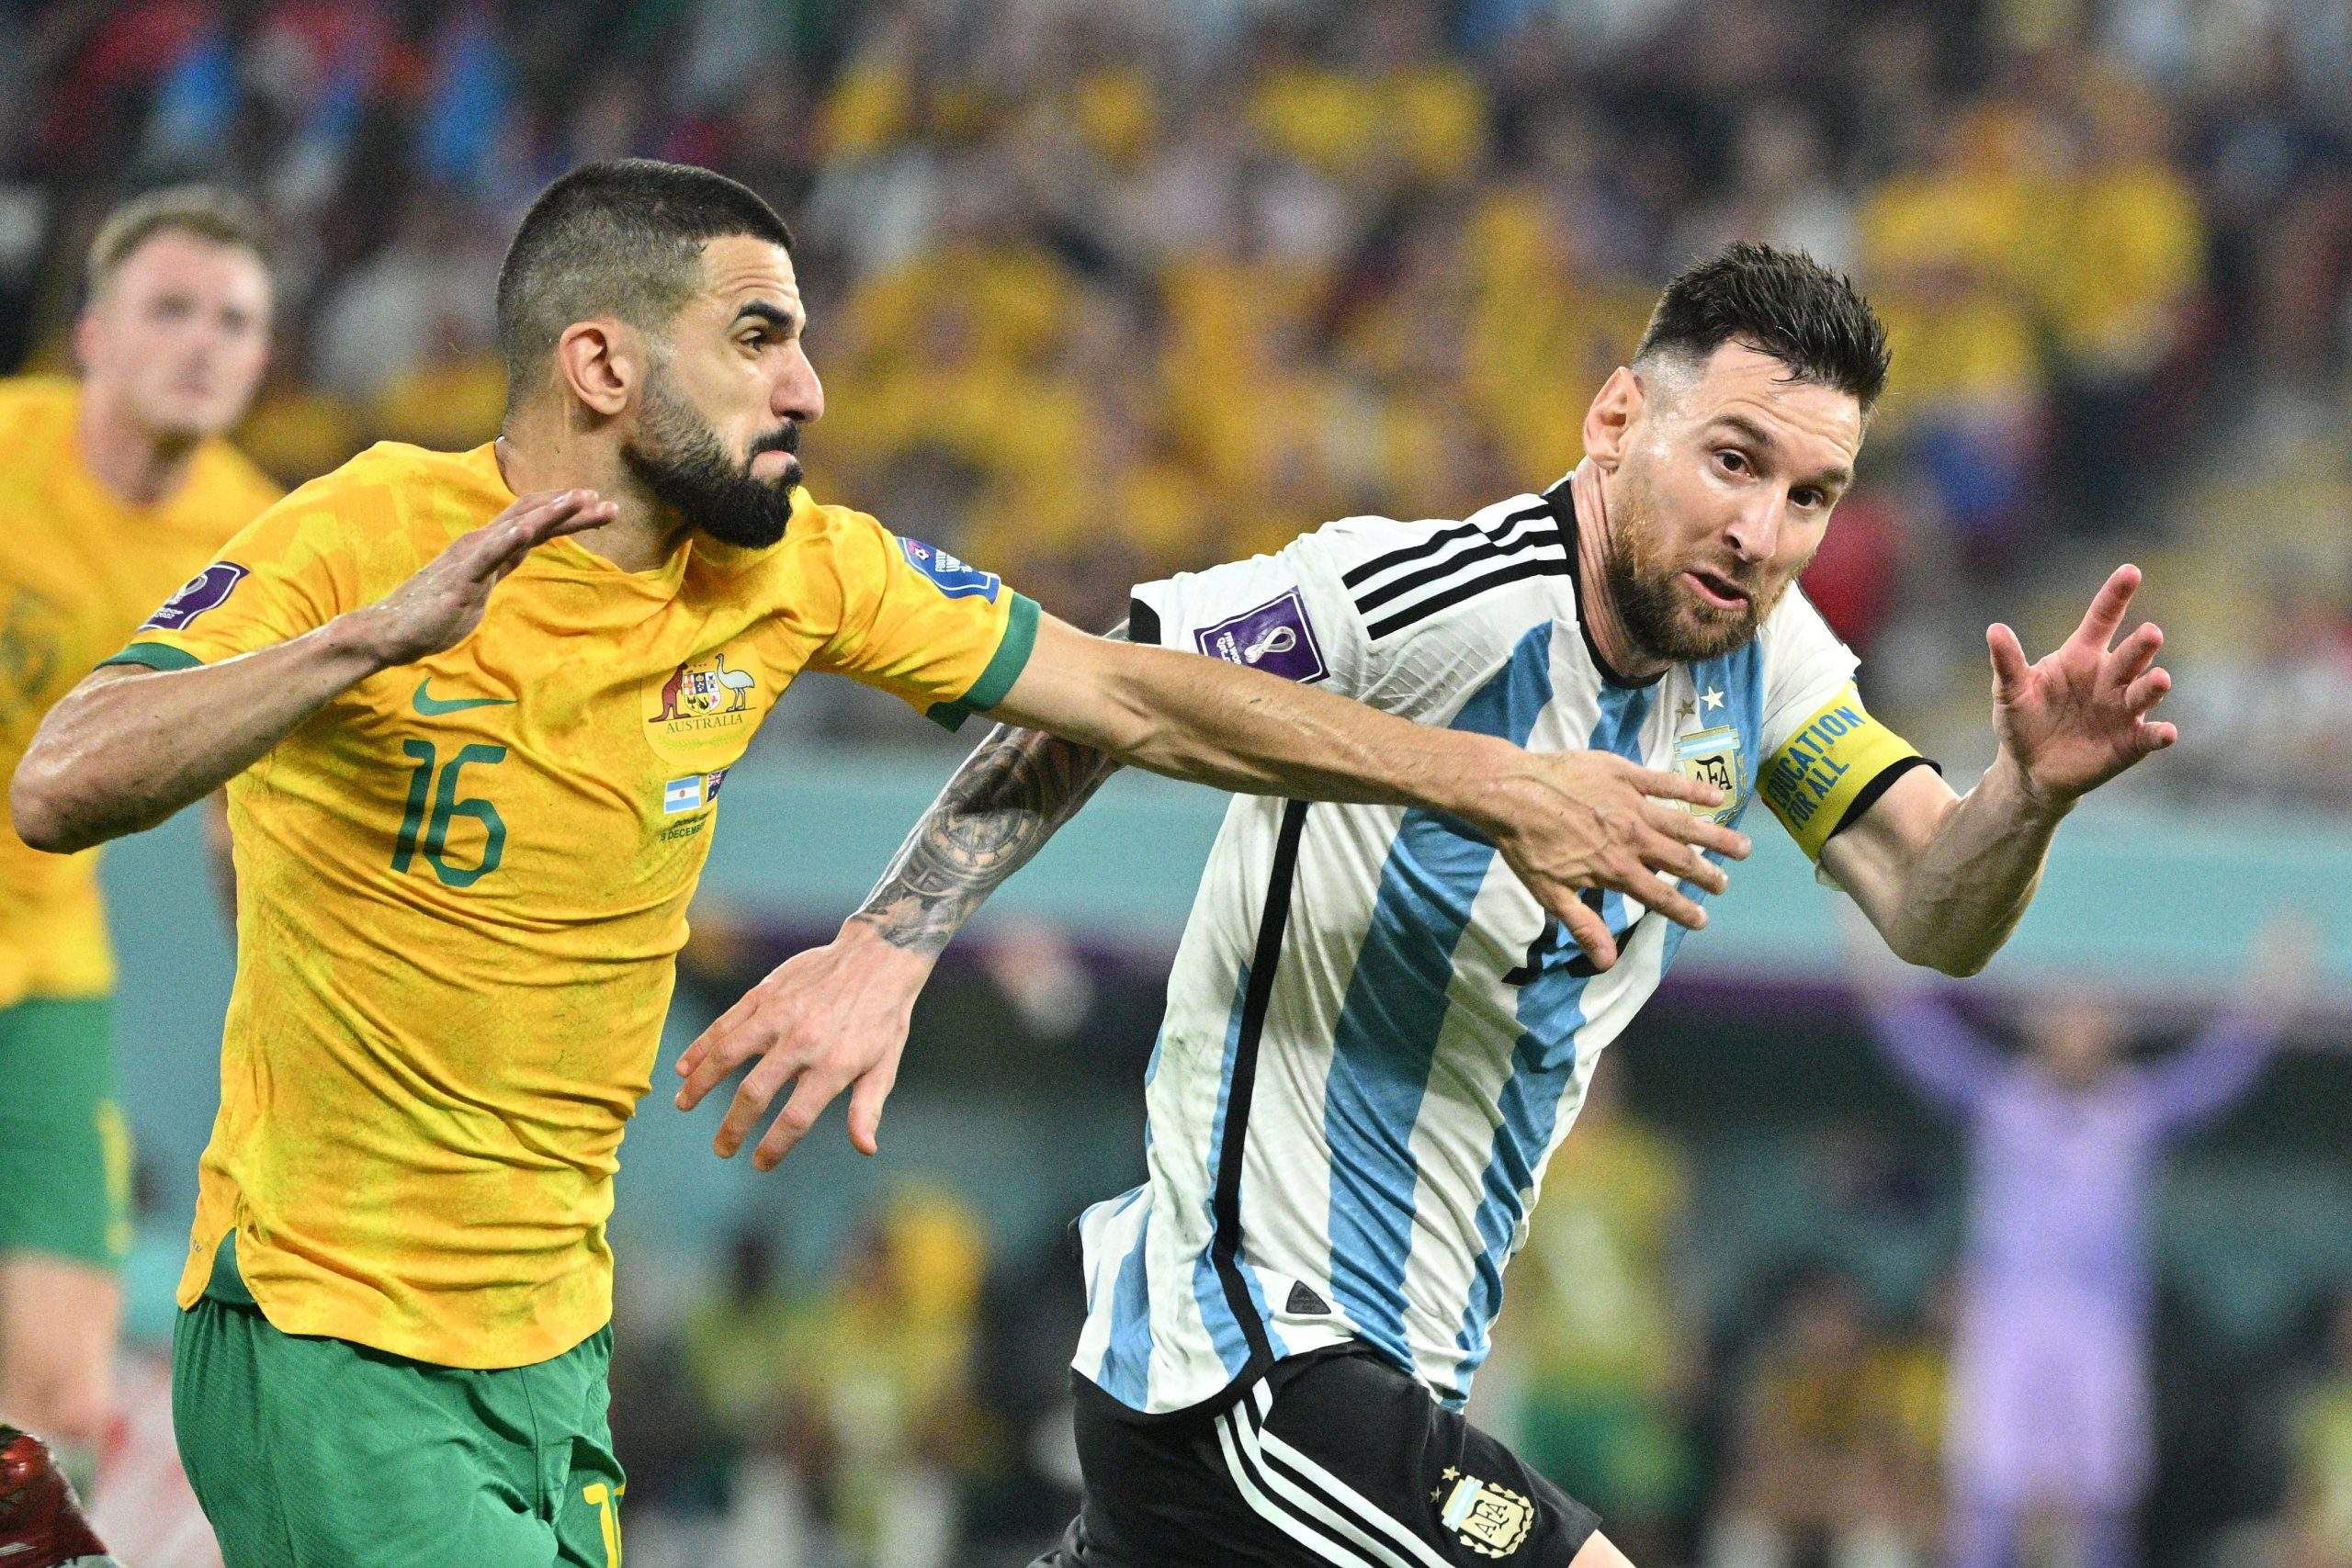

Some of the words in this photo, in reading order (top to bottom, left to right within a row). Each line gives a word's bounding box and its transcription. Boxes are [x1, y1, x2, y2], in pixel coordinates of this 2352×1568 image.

[666, 714, 743, 734] AUSTRALIA
[1768, 705, 1867, 810] EDUCATION
[390, 739, 508, 888] 16
[1788, 791, 1818, 830] FOR
[1806, 756, 1849, 800] ALL
[668, 822, 706, 840] DECEM
[582, 1483, 627, 1568] 1
[1465, 1499, 1510, 1540] AFA
